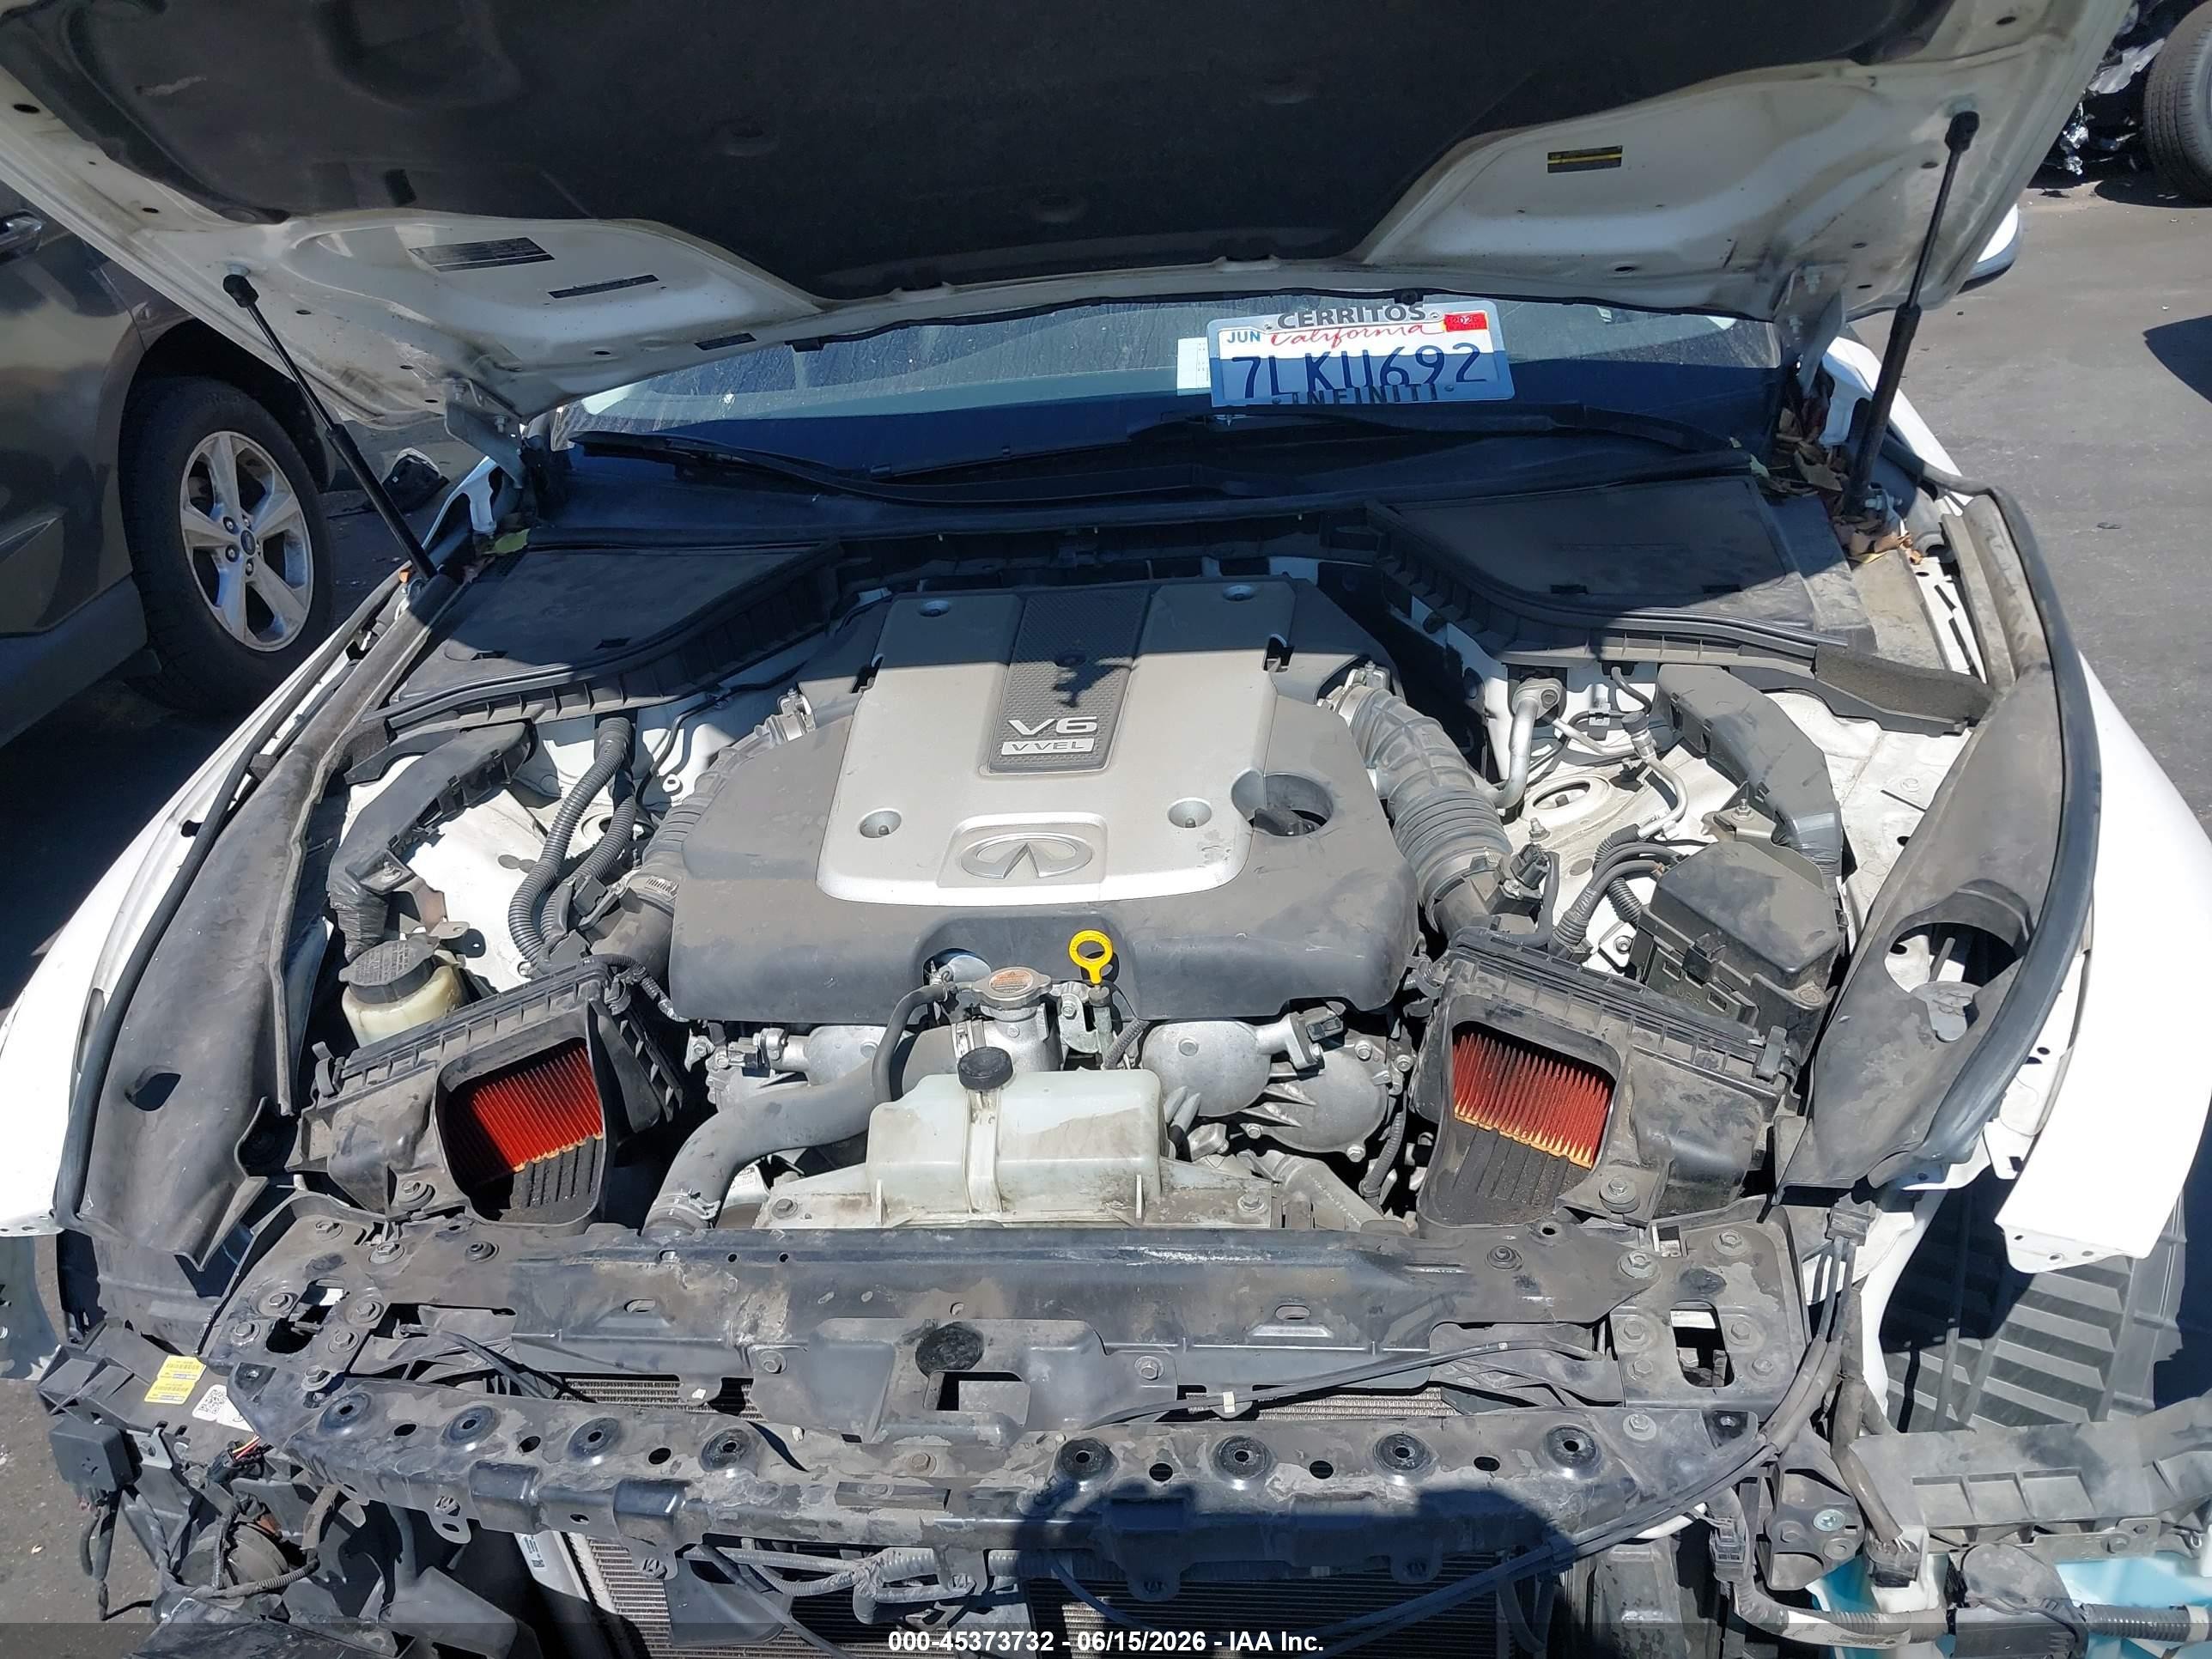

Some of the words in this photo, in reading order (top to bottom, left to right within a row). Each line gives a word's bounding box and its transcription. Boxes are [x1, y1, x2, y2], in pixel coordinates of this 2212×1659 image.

[1277, 305, 1426, 329] CERRITOS
[1227, 331, 1261, 343] JUN
[1270, 322, 1443, 349] California
[1231, 342, 1486, 398] 7LKU692
[1291, 383, 1438, 405] INFINITI
[1008, 716, 1097, 736] V6
[1012, 740, 1085, 751] VVEL
